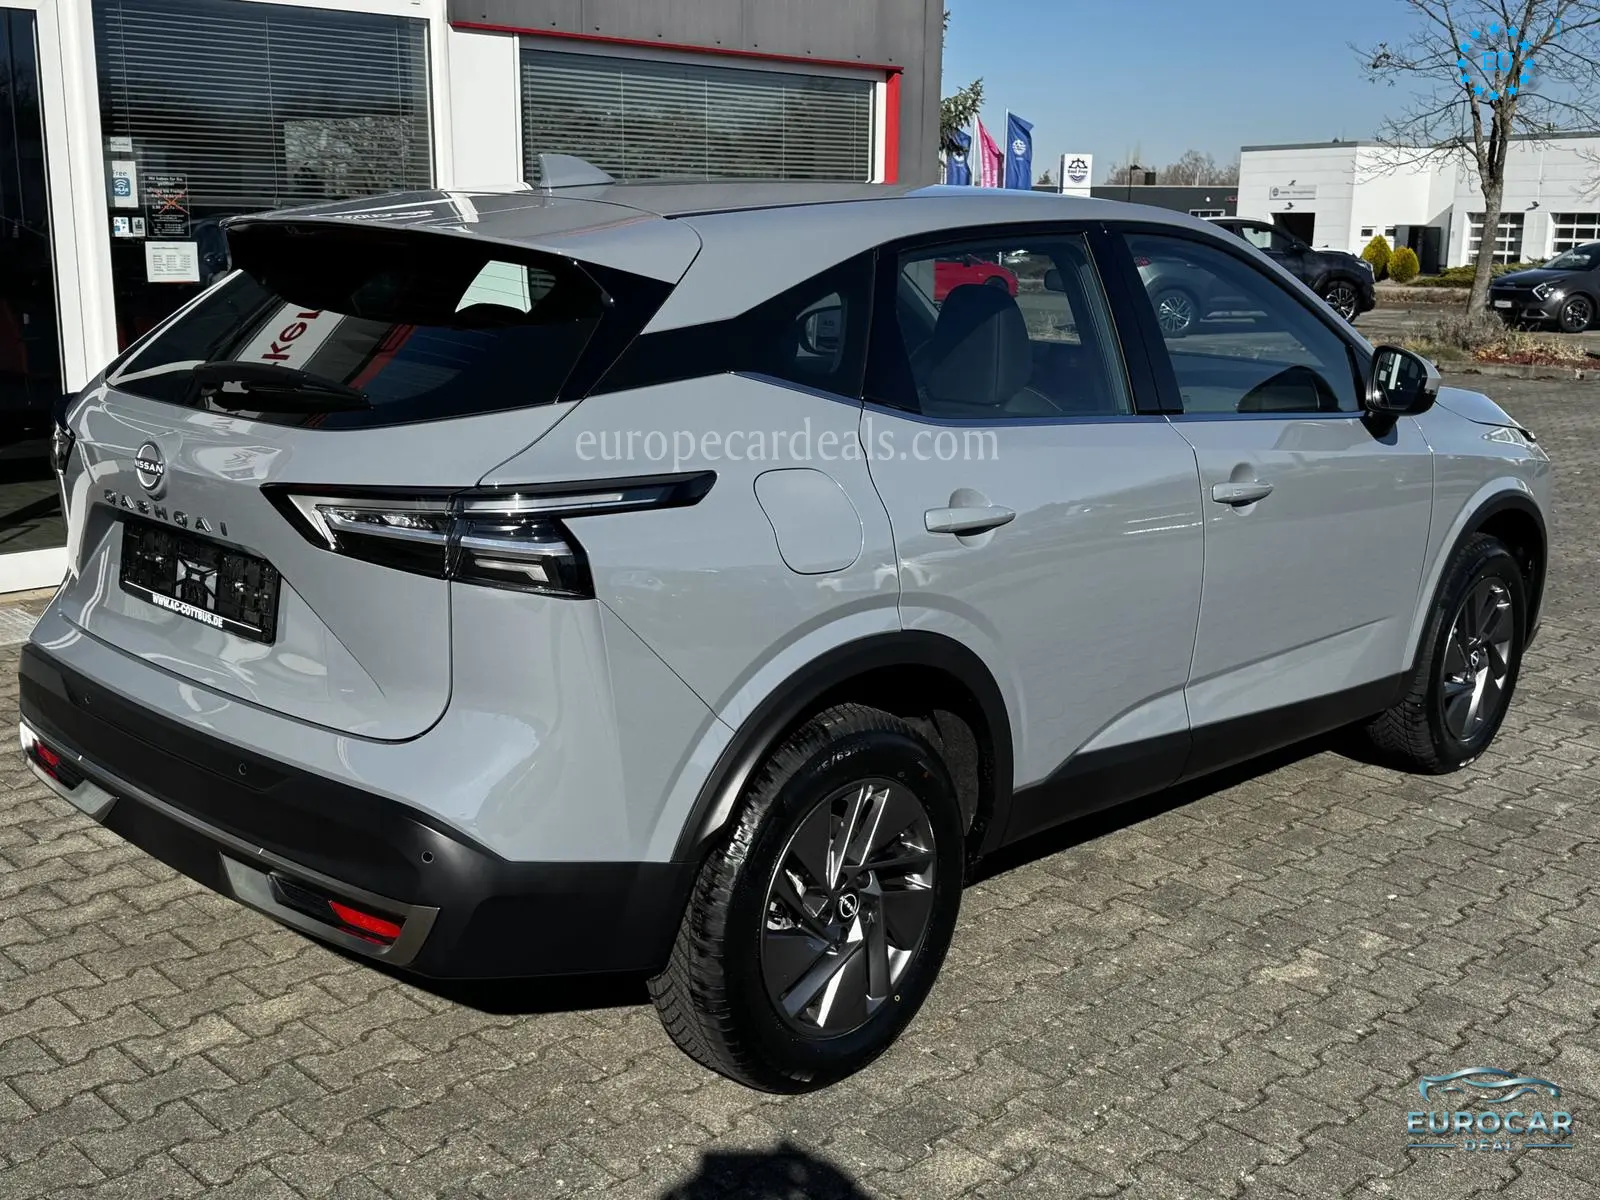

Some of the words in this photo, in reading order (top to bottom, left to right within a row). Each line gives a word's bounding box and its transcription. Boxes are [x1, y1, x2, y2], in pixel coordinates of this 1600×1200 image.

[135, 459, 163, 474] NISSAN
[104, 489, 228, 536] QASHQAI
[152, 593, 223, 628] WWW.AC-COTTBUS.DE
